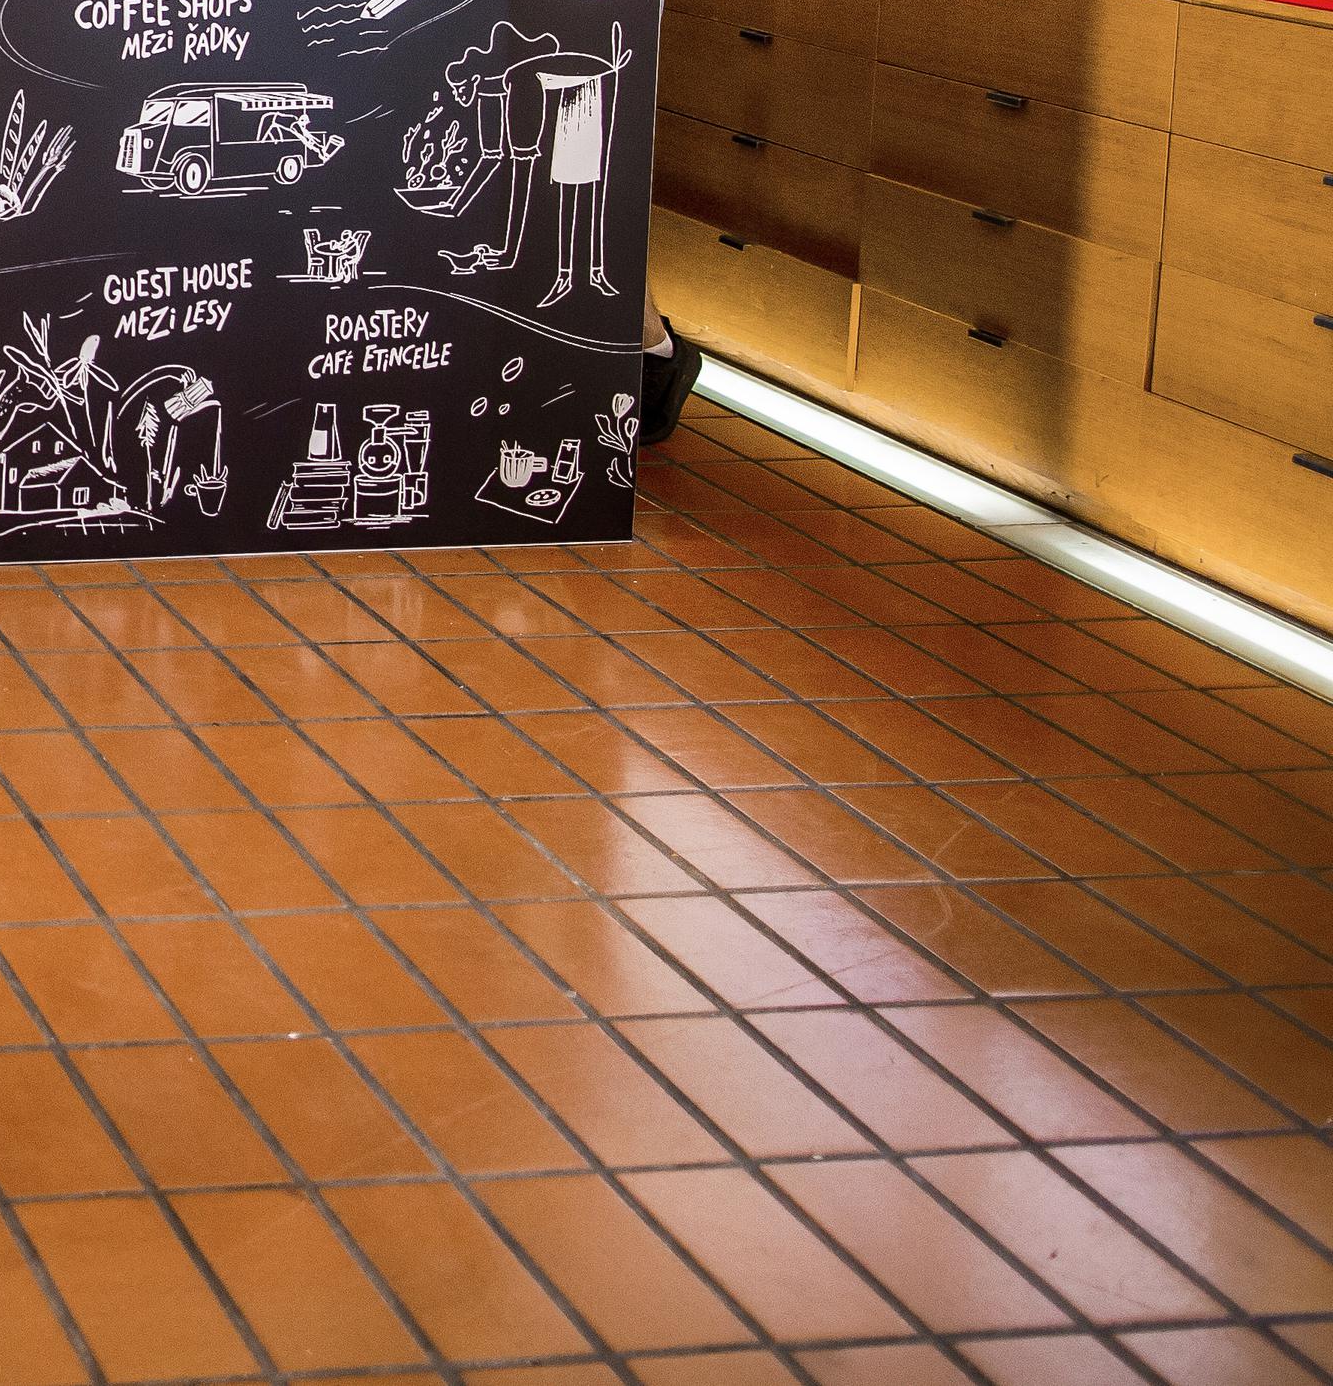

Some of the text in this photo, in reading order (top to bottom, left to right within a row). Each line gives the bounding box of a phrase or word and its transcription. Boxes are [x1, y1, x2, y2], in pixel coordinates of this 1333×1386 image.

[184, 23, 250, 63] ŘÁDKY
[104, 259, 252, 304] GUEST HOUSE
[183, 300, 231, 332] LESY
[326, 308, 429, 344] ROASTERY
[308, 350, 353, 379] CAFÉ
